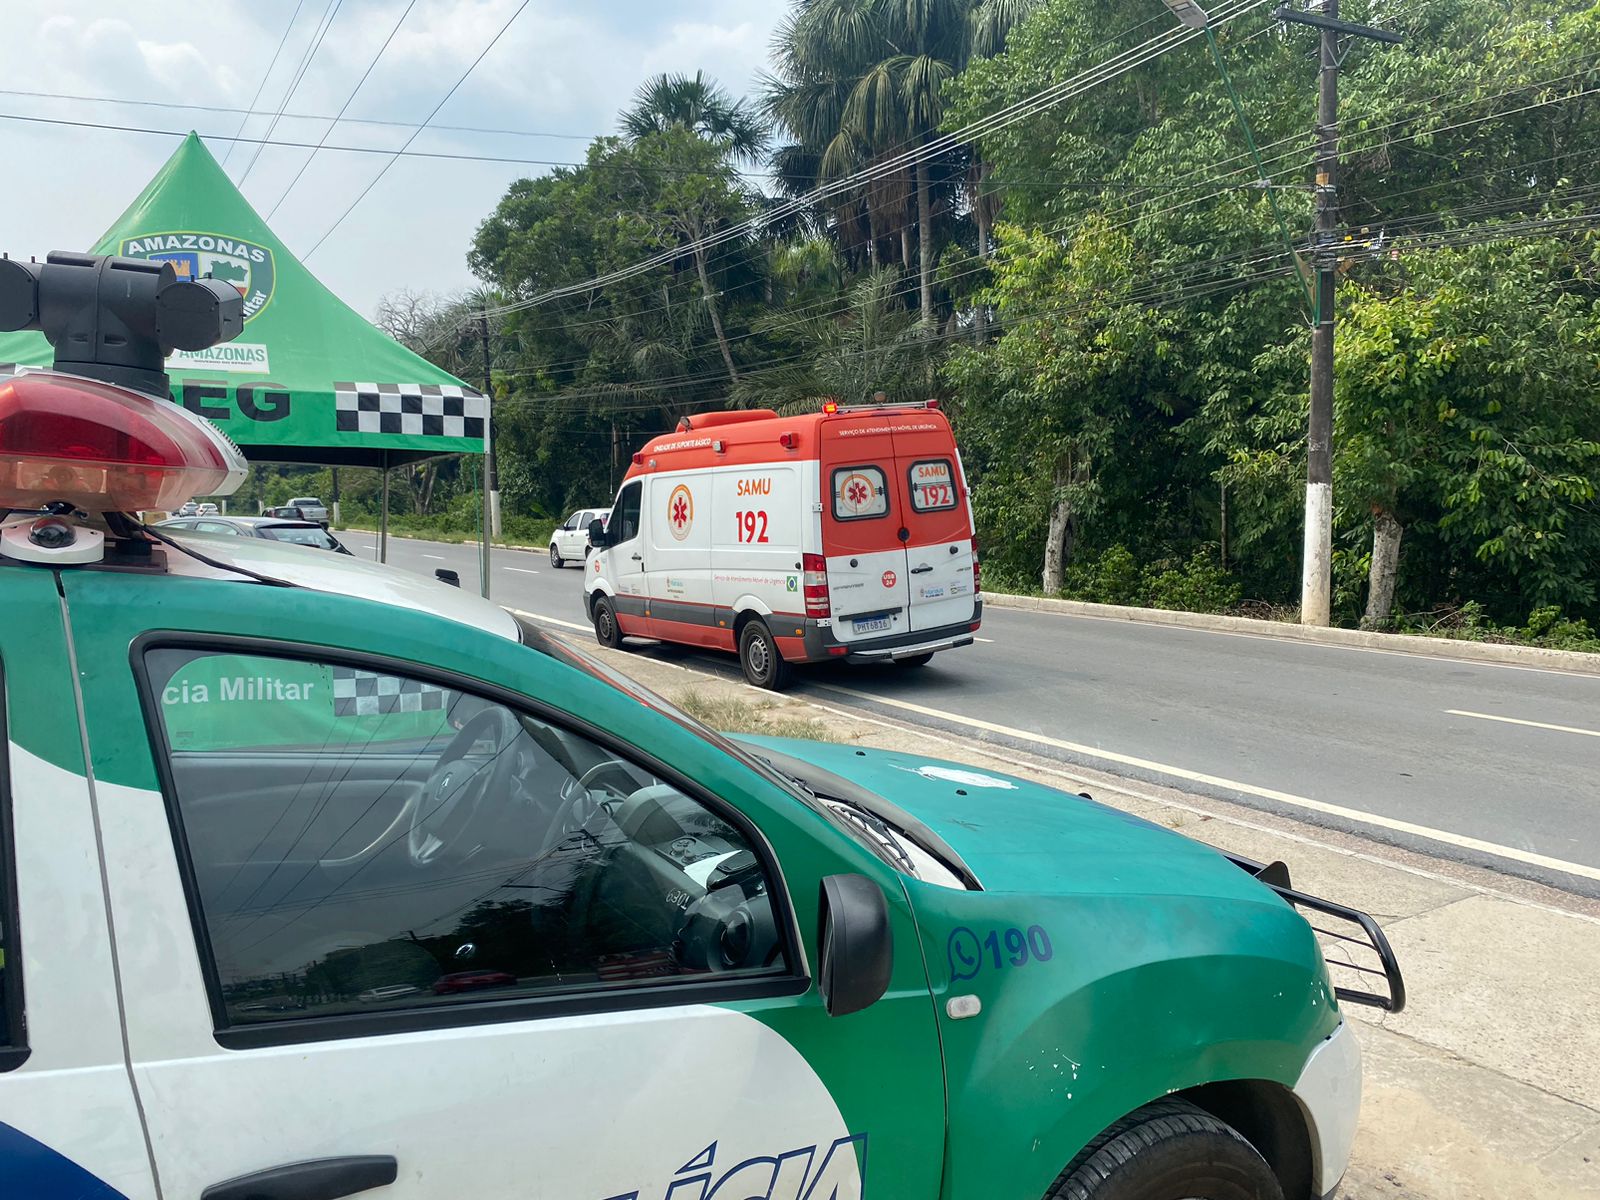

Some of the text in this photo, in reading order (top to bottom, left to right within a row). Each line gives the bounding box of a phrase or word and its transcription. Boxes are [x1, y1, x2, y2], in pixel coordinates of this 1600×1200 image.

[128, 235, 265, 263] AMAZONAS
[169, 379, 290, 422] EG
[918, 465, 947, 477] SAMU
[737, 478, 771, 496] SAMU
[921, 484, 950, 506] 192
[735, 511, 769, 543] 192
[219, 676, 315, 701] Militar
[984, 924, 1053, 970] 190
